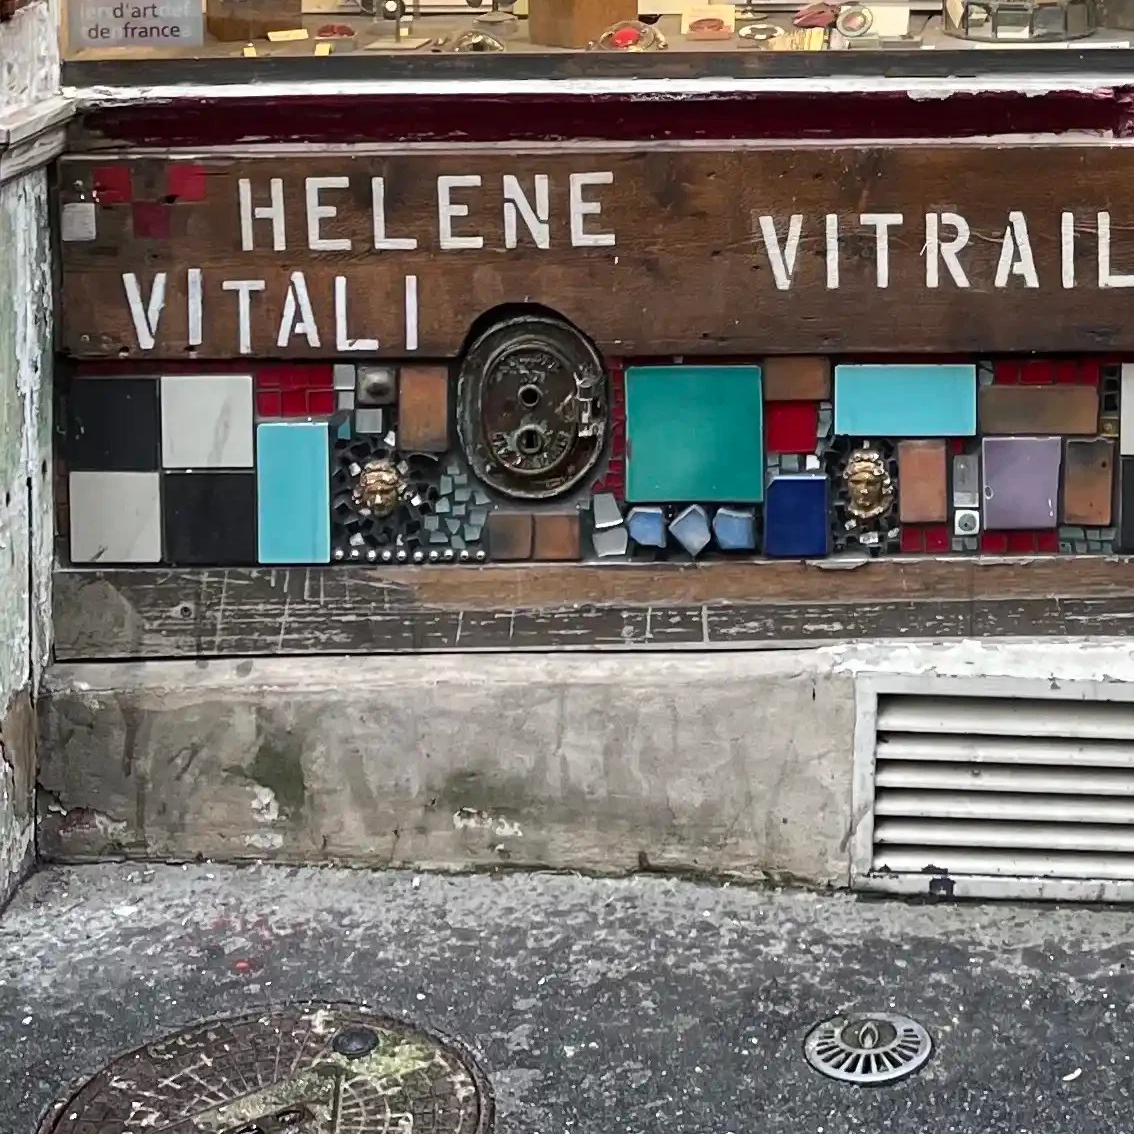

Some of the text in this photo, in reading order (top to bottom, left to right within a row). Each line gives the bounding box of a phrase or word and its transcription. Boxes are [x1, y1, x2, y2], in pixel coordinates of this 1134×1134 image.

[87, 21, 181, 40] de france
[112, 2, 158, 19] d'art
[238, 170, 616, 252] HELENE
[122, 267, 419, 354] VITALI
